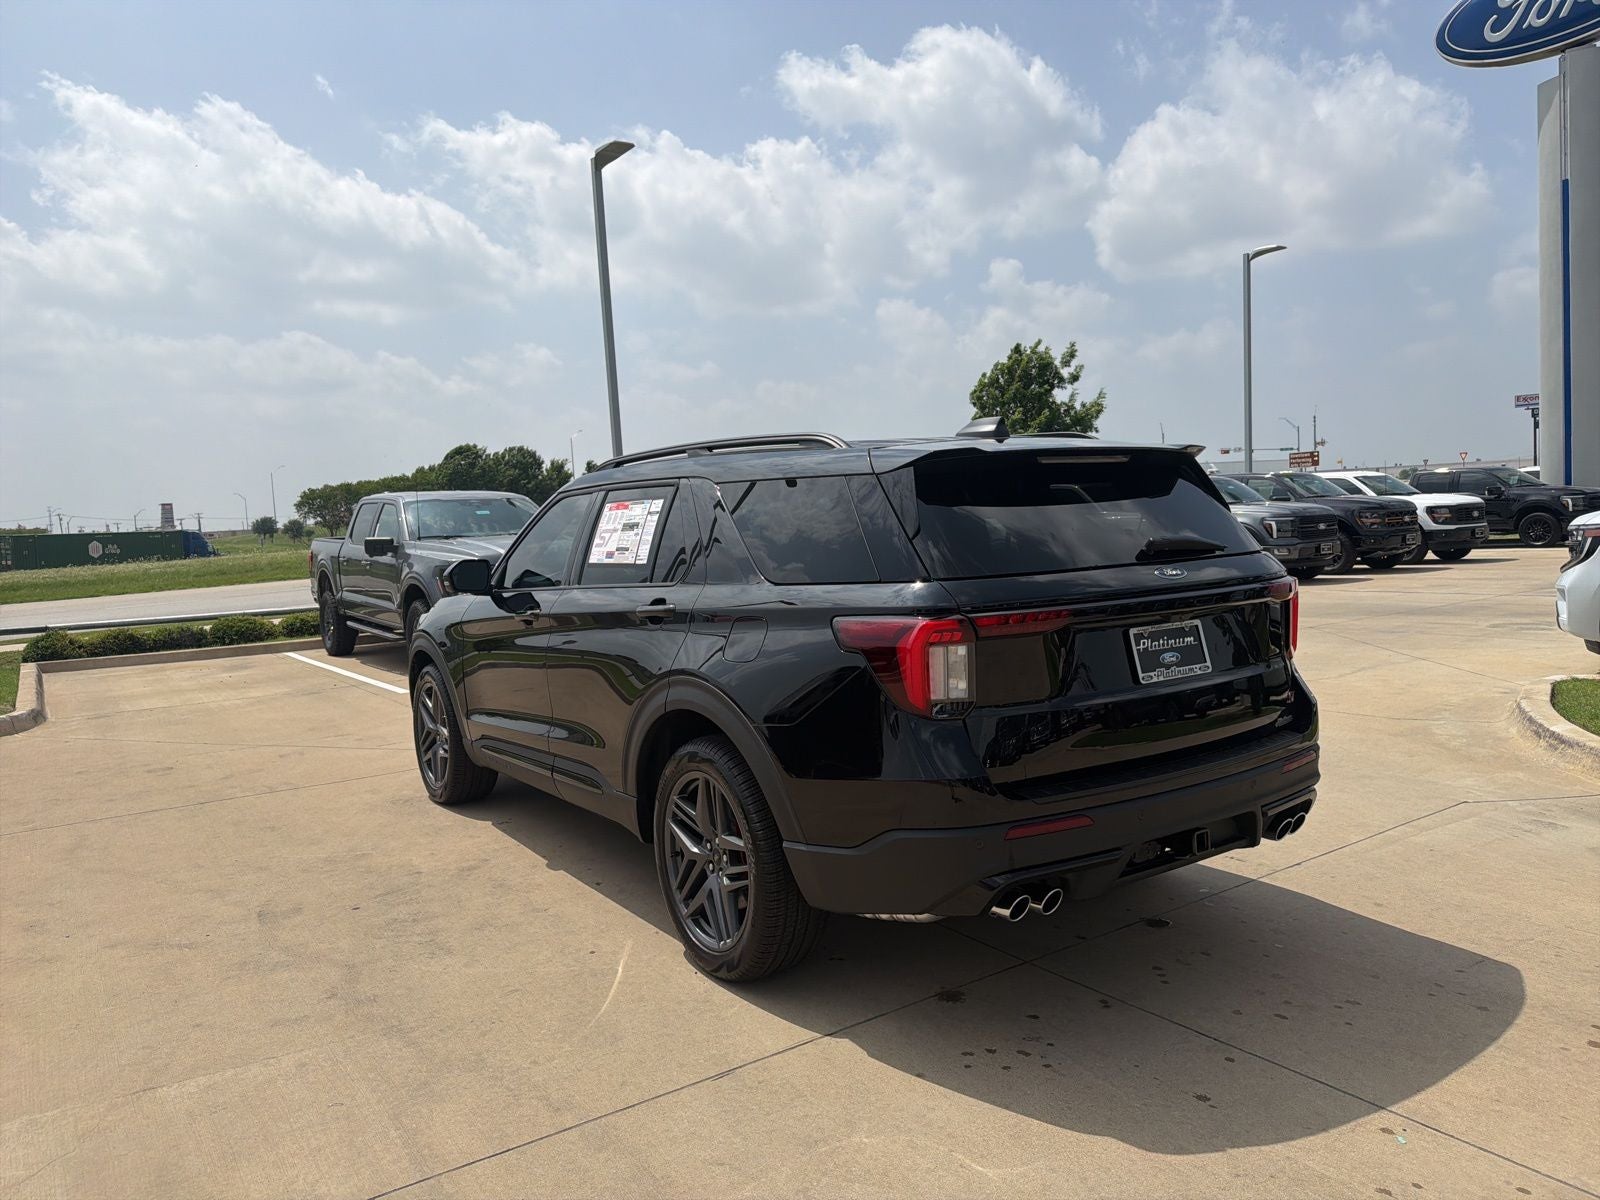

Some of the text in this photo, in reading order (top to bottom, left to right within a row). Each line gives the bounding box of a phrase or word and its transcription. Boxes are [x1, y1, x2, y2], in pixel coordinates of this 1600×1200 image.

[1517, 395, 1539, 403] Exxon
[1136, 635, 1198, 652] Platinum
[1156, 666, 1196, 680] Platinum
